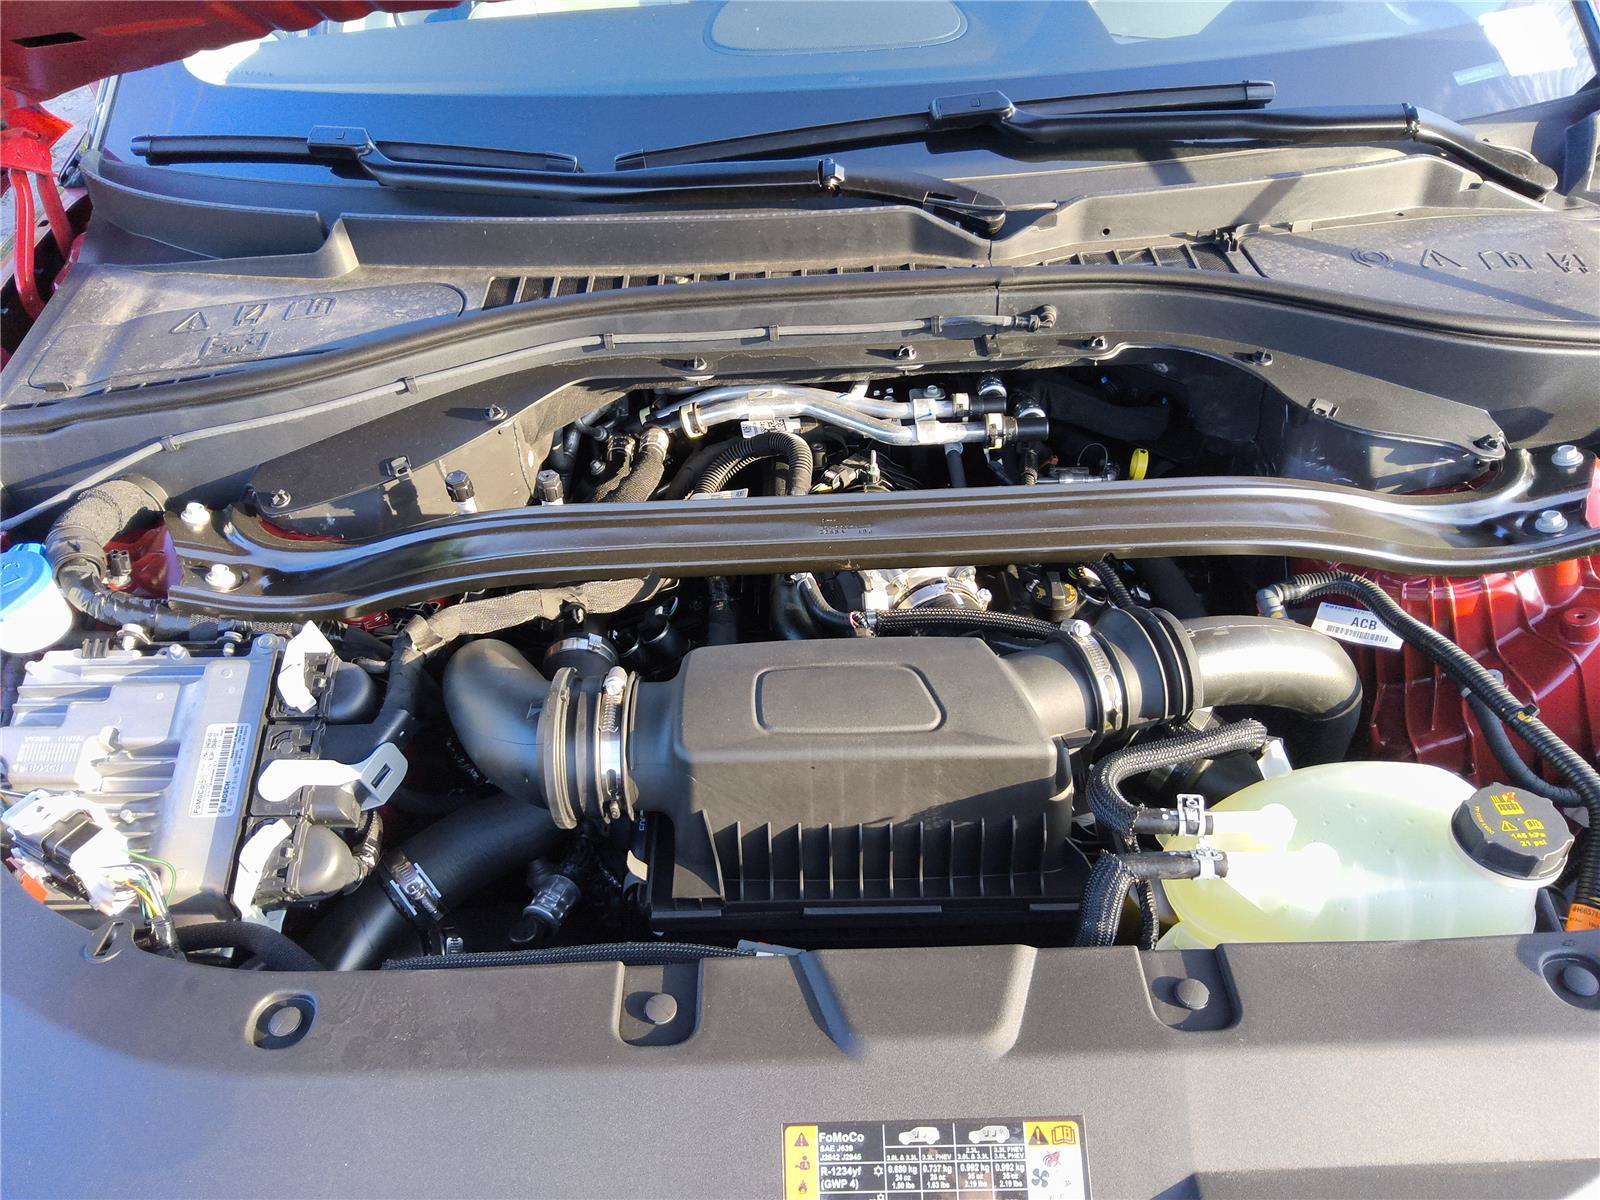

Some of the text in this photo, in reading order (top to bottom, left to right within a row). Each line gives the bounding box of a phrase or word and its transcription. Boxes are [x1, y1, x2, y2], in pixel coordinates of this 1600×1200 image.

[1350, 617, 1377, 630] ACB
[221, 781, 231, 803] BOSCH
[819, 1131, 865, 1143] FoMoCo
[820, 1144, 854, 1152] SAE J639
[820, 1166, 862, 1178] R-1234yf
[908, 1165, 918, 1175] kg
[922, 1164, 953, 1175] 0.737 kg
[980, 1163, 990, 1174] kg
[995, 1163, 1025, 1174] 0.992 kg
[820, 1180, 859, 1190] (GWP 4)
